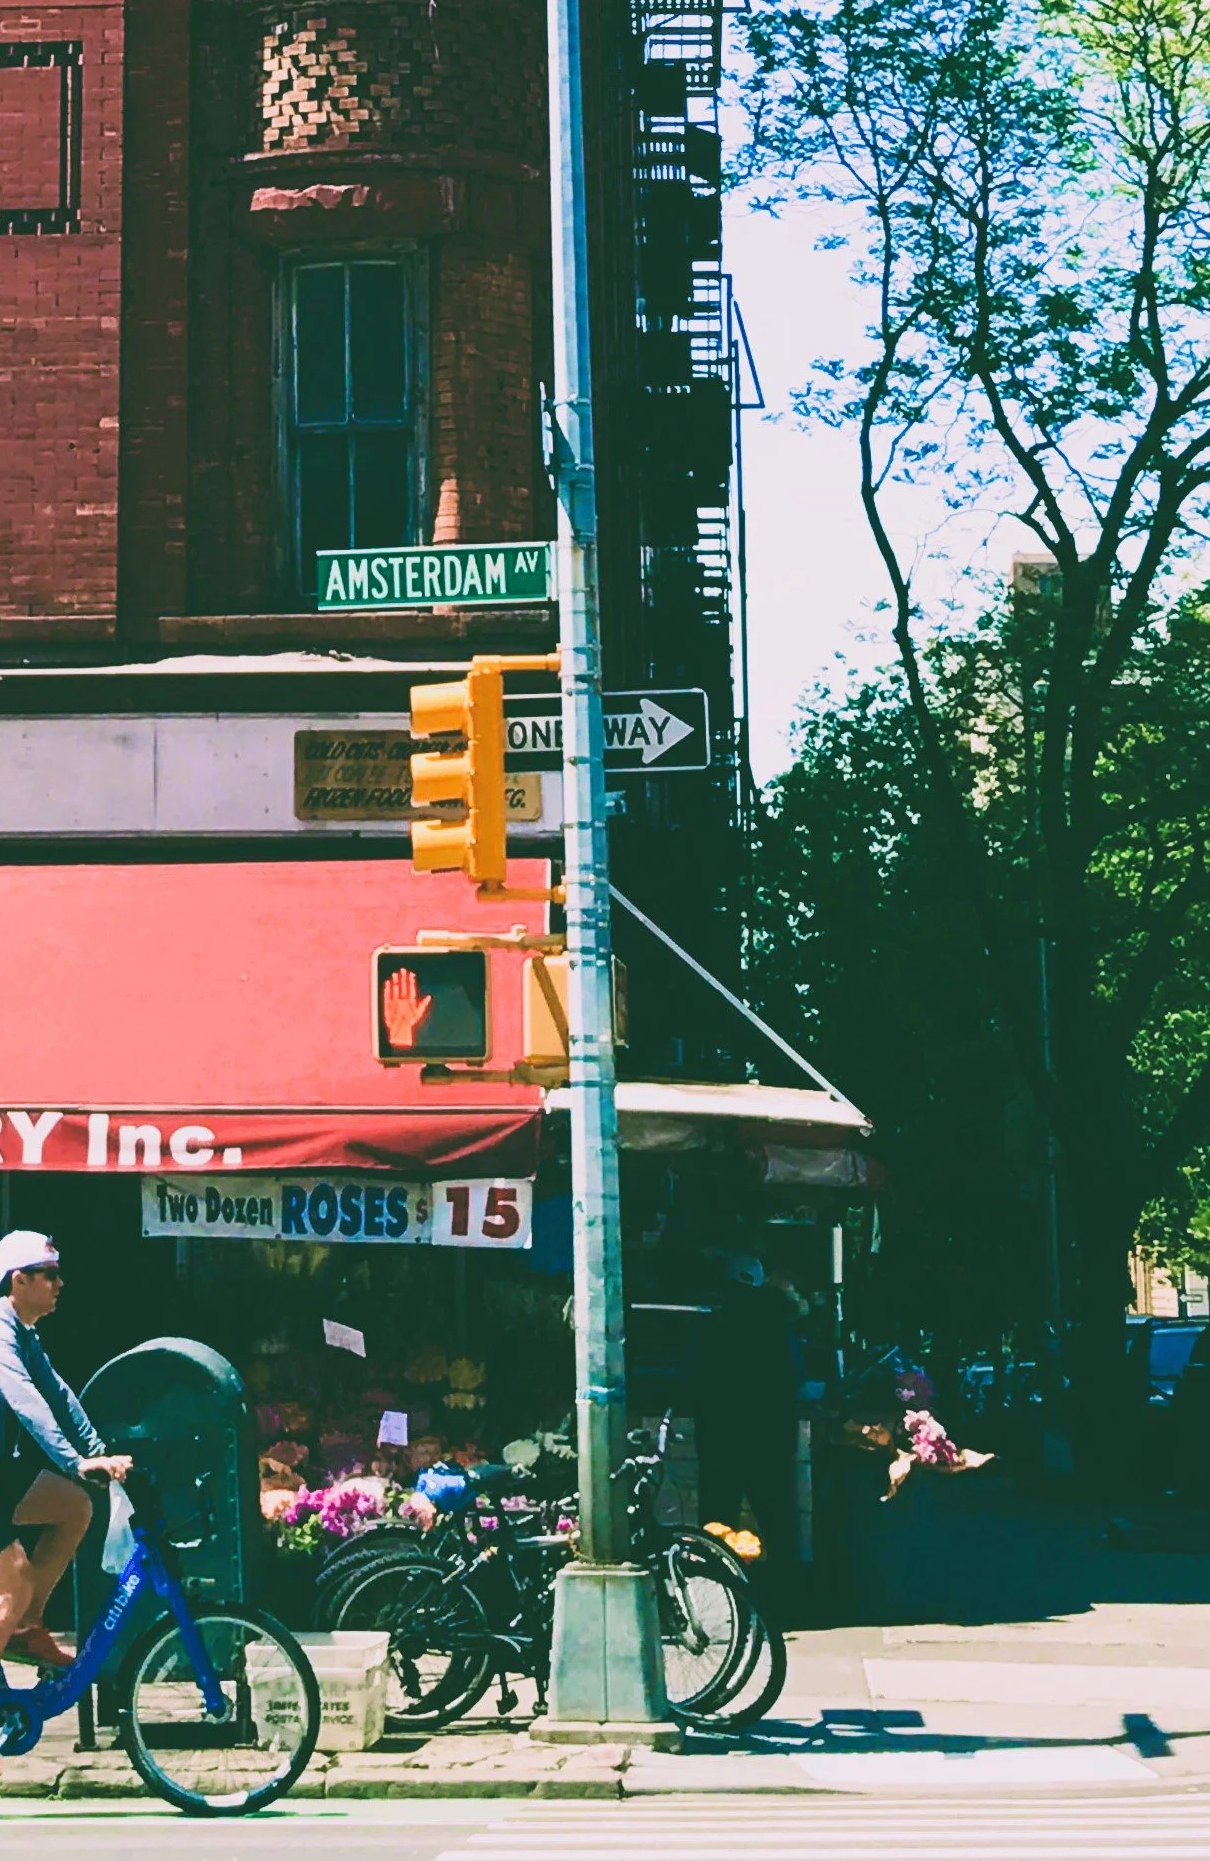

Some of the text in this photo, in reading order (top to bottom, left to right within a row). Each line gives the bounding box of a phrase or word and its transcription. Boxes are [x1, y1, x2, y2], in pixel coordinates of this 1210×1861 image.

[325, 550, 539, 601] AMSTERDAM AV
[507, 715, 671, 749] ONE WAY
[87, 1113, 243, 1167] Inc.
[156, 1184, 198, 1224] Two
[205, 1186, 274, 1226] Dozen
[281, 1182, 409, 1239] ROSES
